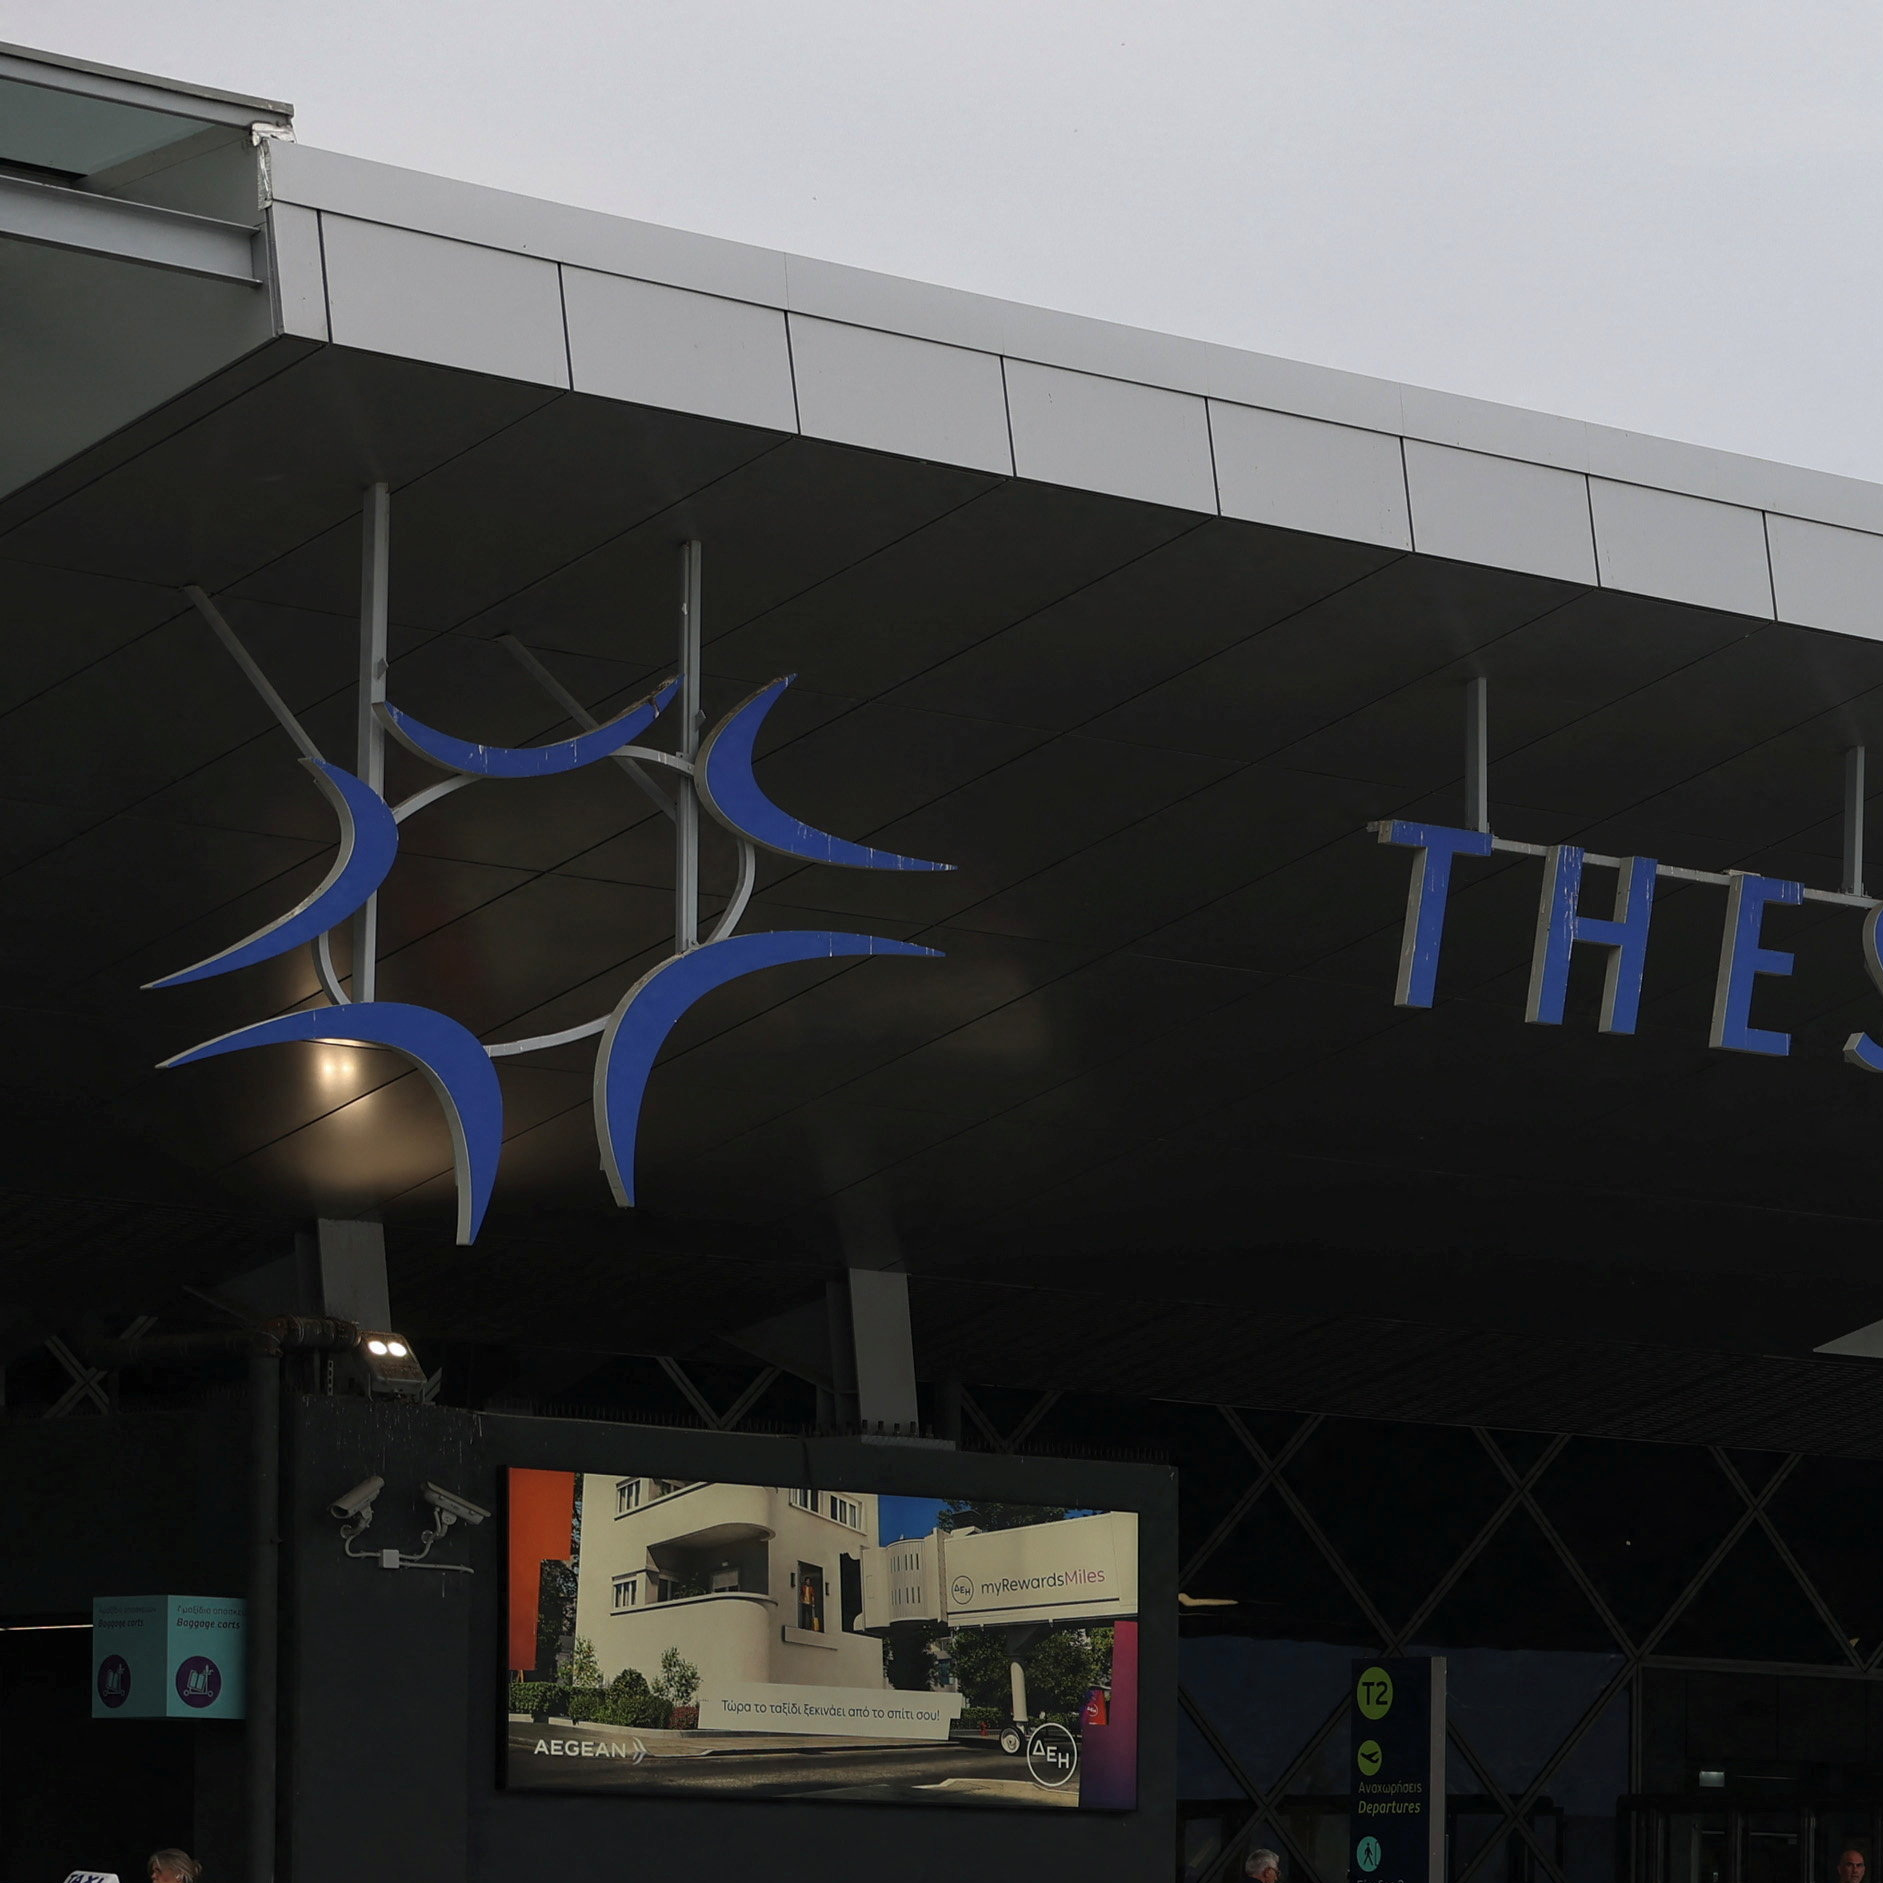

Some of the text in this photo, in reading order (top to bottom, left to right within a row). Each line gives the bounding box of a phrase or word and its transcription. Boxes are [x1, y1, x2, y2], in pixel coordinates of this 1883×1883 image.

[981, 1569, 1105, 1596] myRewardsMiles
[176, 1617, 241, 1631] Baggage carts
[1362, 1681, 1388, 1706] T2
[721, 1699, 941, 1722] Τώρα το ταξίδι ξεκινάει από το σπίτι σου!
[534, 1739, 626, 1759] AEGEAN
[1032, 1740, 1069, 1768] ΔΕΗ
[1358, 1780, 1423, 1796] Αναχωρήσεις
[1358, 1801, 1422, 1817] Departures
